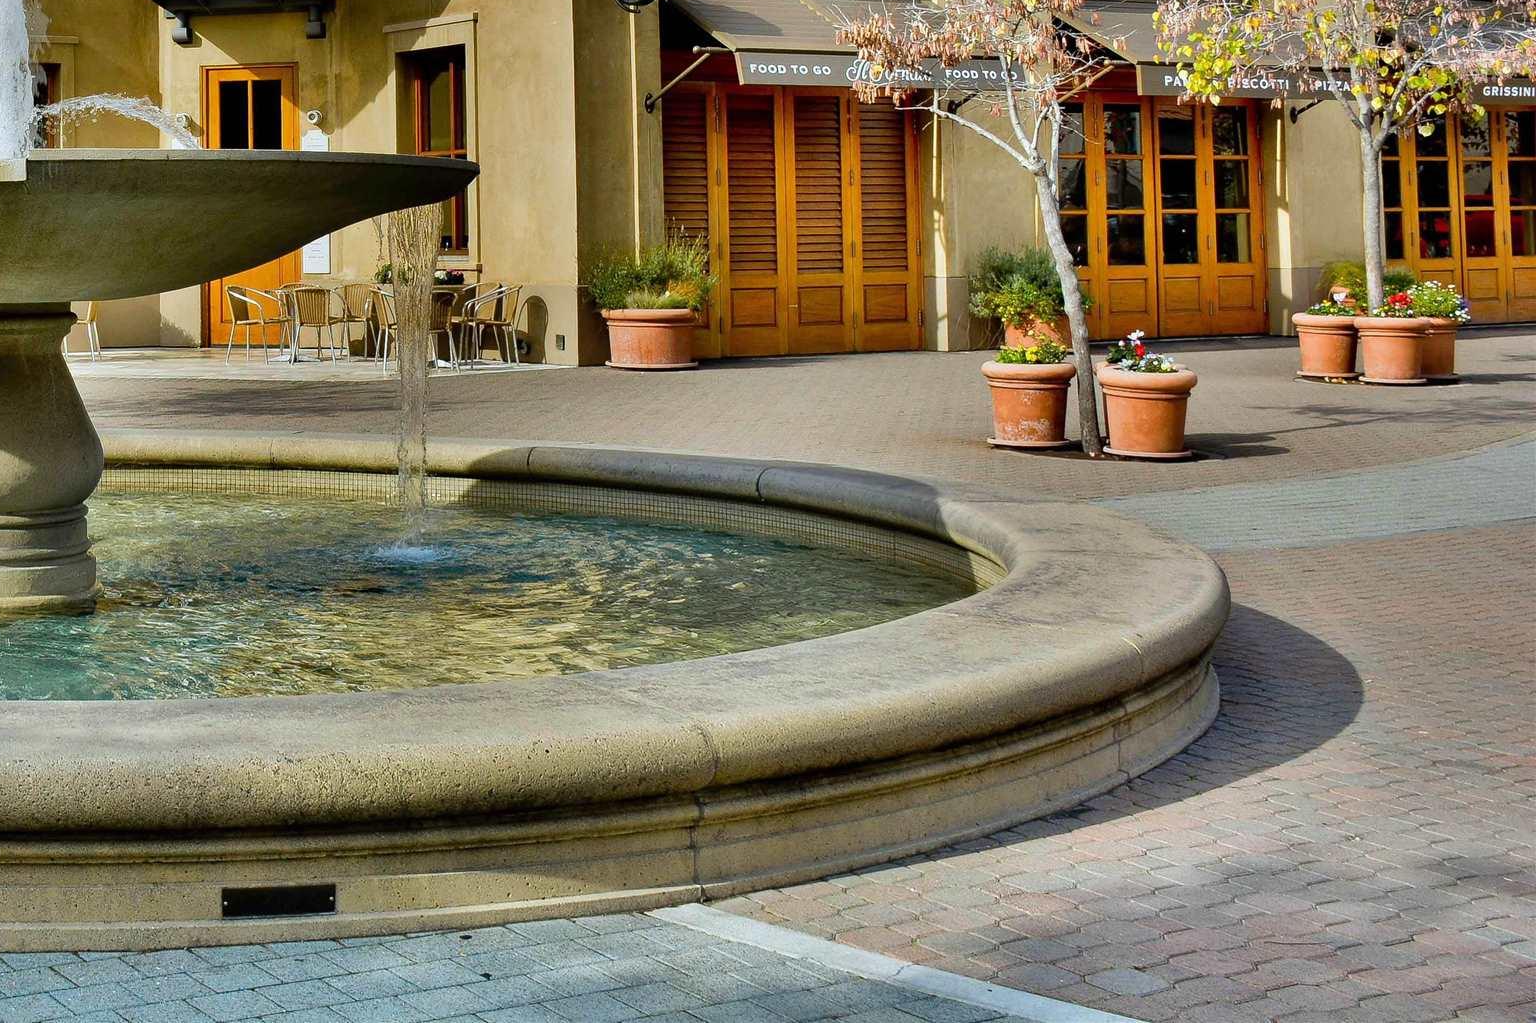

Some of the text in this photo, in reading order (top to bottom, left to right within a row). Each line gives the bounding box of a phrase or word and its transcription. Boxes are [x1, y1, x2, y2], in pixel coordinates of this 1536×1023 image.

[749, 63, 787, 75] FOOD
[790, 64, 809, 75] TO
[812, 65, 832, 76] GO
[945, 69, 979, 79] FOOD
[982, 70, 997, 80] TO
[1482, 85, 1536, 97] GRISSINI
